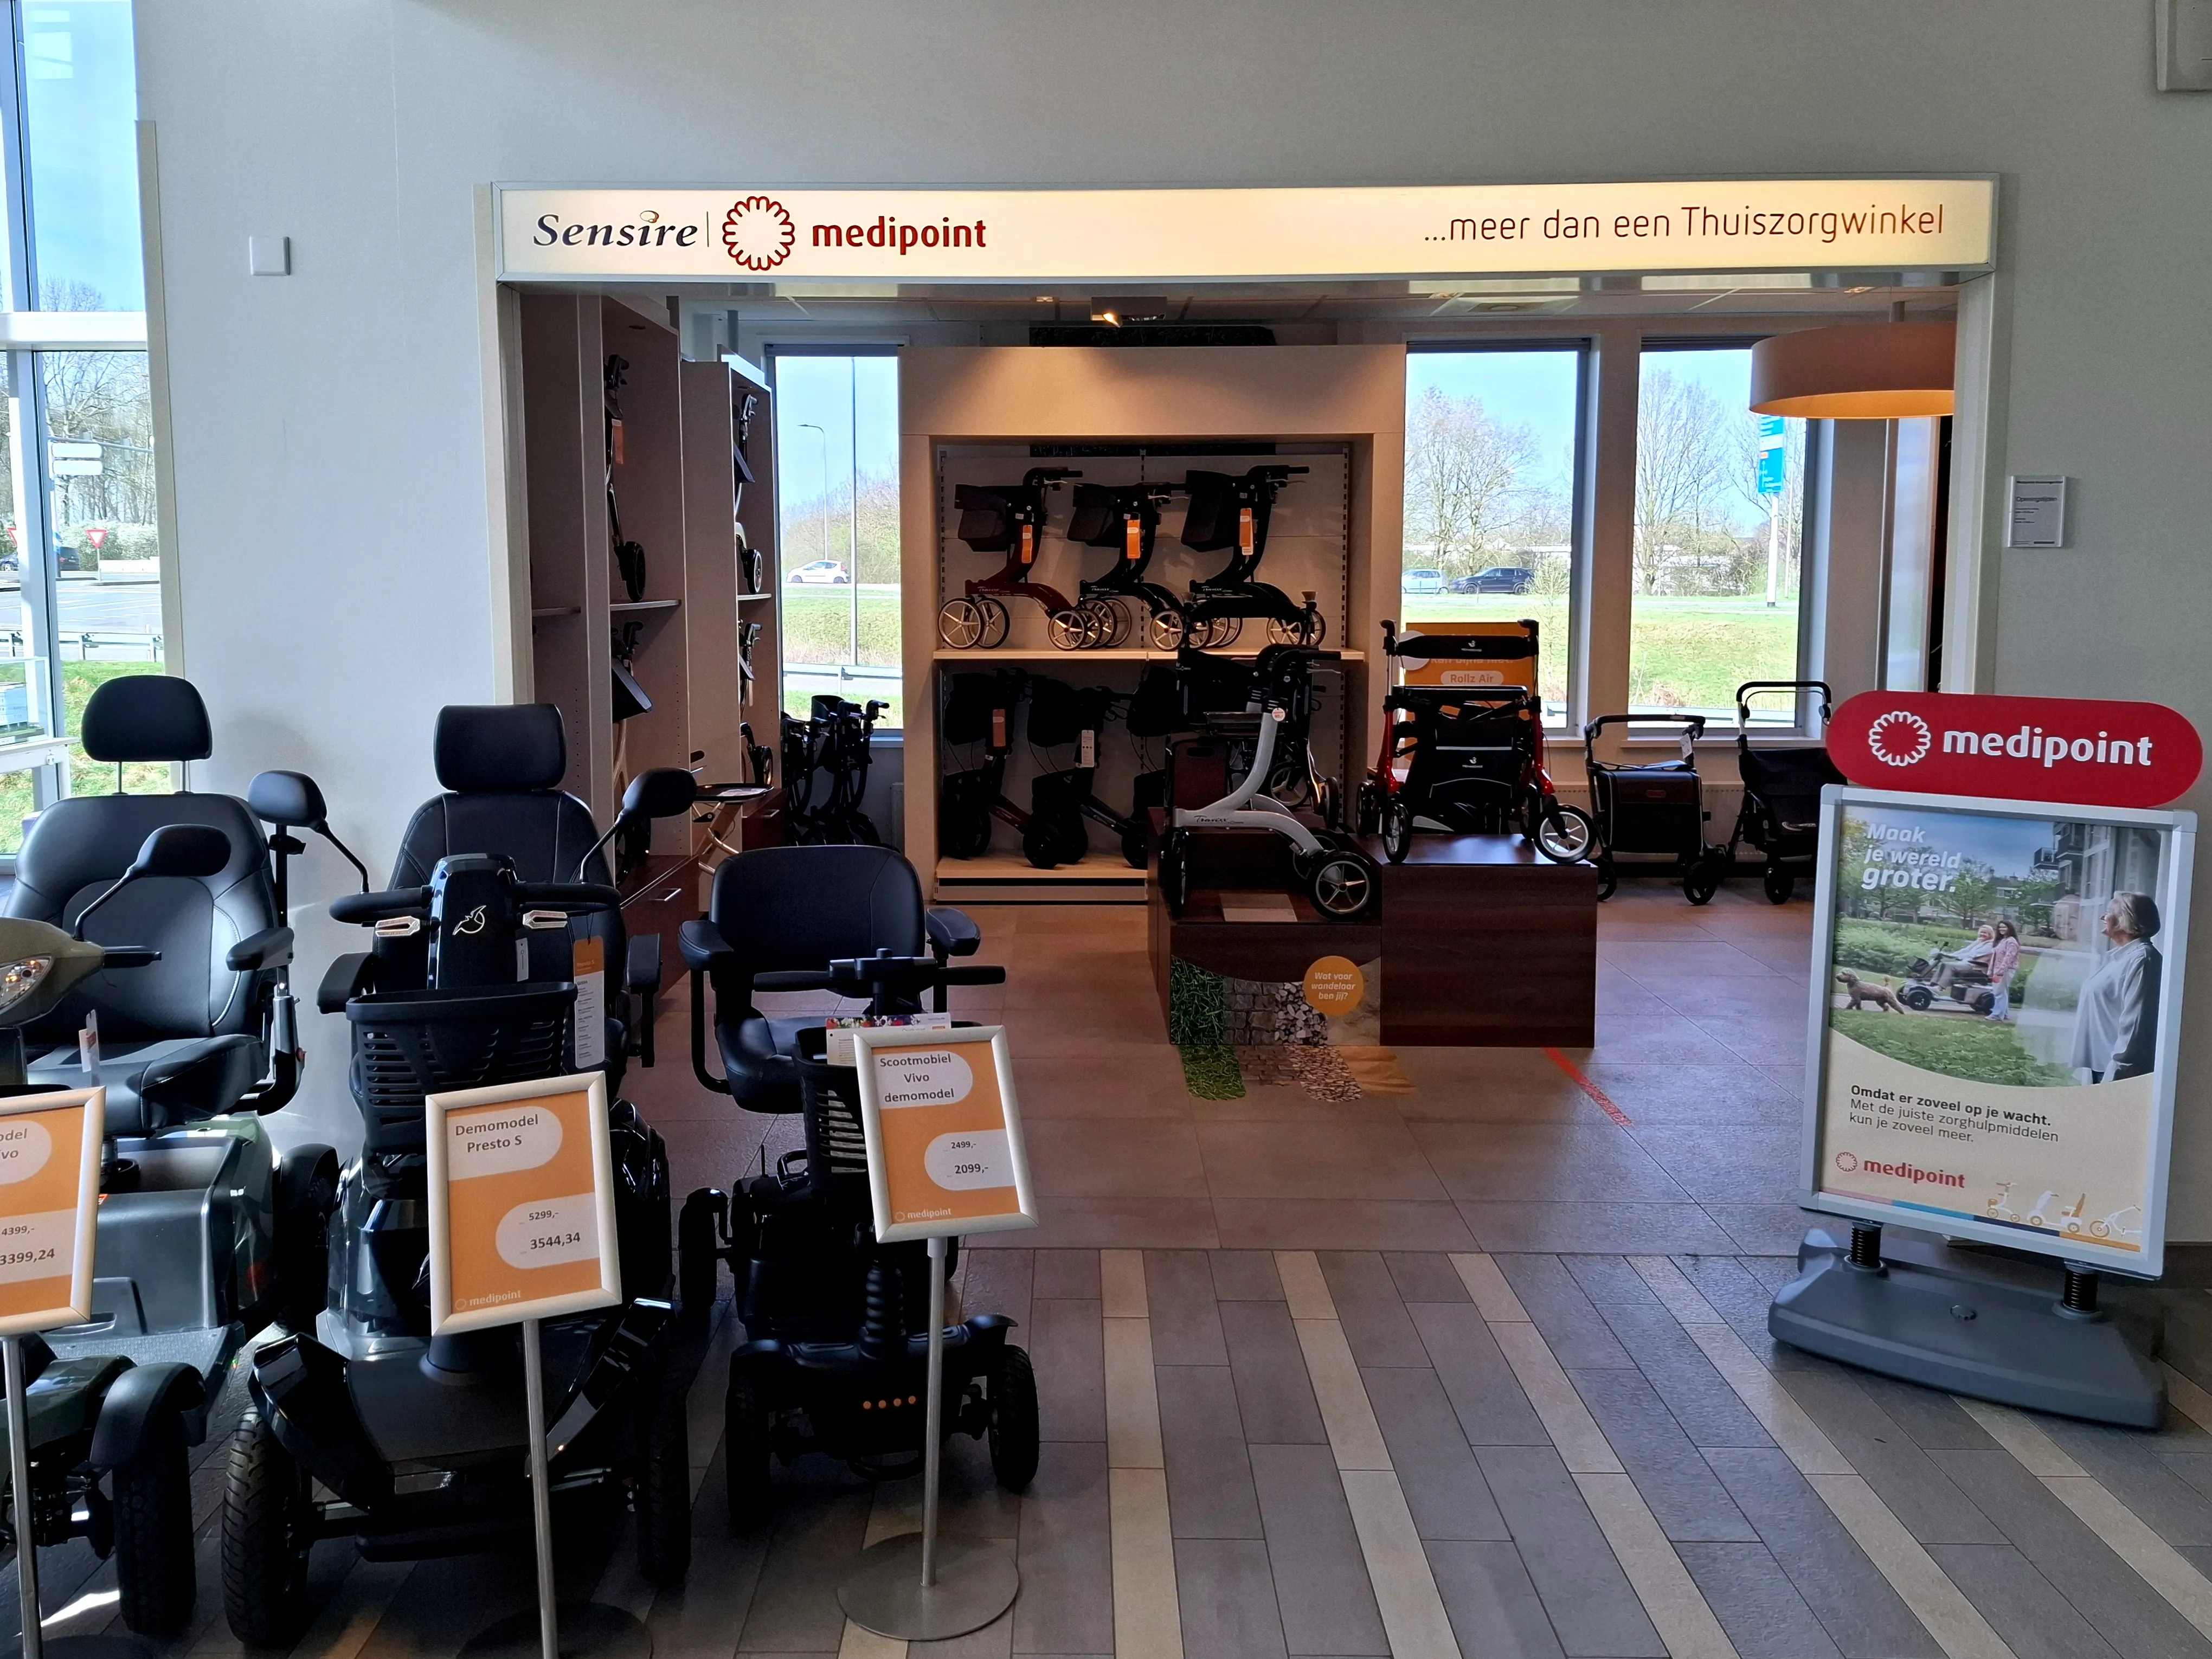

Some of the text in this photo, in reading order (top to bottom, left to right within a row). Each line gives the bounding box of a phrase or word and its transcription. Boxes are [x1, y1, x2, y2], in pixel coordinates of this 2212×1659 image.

[1424, 204, 1944, 243] ...meer dan een Thuiszorgwinkel
[532, 211, 986, 255] Sensire medipoint
[1450, 674, 1494, 683] Rollz Air
[1943, 726, 2153, 768] medipoint
[1867, 823, 1926, 843] Maak
[1864, 845, 1962, 869] je wereld
[1861, 867, 1956, 892] groter.
[1311, 982, 1356, 990] wandelaar
[1335, 992, 1348, 1001] jij?
[880, 1053, 951, 1067] Scootmobiel
[904, 1072, 930, 1083] Vivo
[884, 1088, 954, 1103] demomodel
[1851, 1085, 2051, 1126] Omdat er zoveel op je wacht.
[455, 1114, 539, 1136] Demomodel
[1849, 1113, 1973, 1142] kun je zoveel meer.
[1850, 1099, 2059, 1142] Met de juiste zorghulpmiddelen
[467, 1135, 522, 1153] Presto S
[951, 1140, 977, 1150] 2499,-
[0, 1150, 18, 1159] vo
[954, 1162, 989, 1175] 2099,-
[1863, 1159, 1965, 1188] medipoint
[529, 1210, 559, 1221] 5299,-
[908, 1208, 951, 1219] medipoint
[1, 1225, 35, 1236] 4399,-
[530, 1232, 581, 1250] 3544,34
[0, 1248, 55, 1265] 3399,24
[470, 1289, 522, 1306] medipoint
